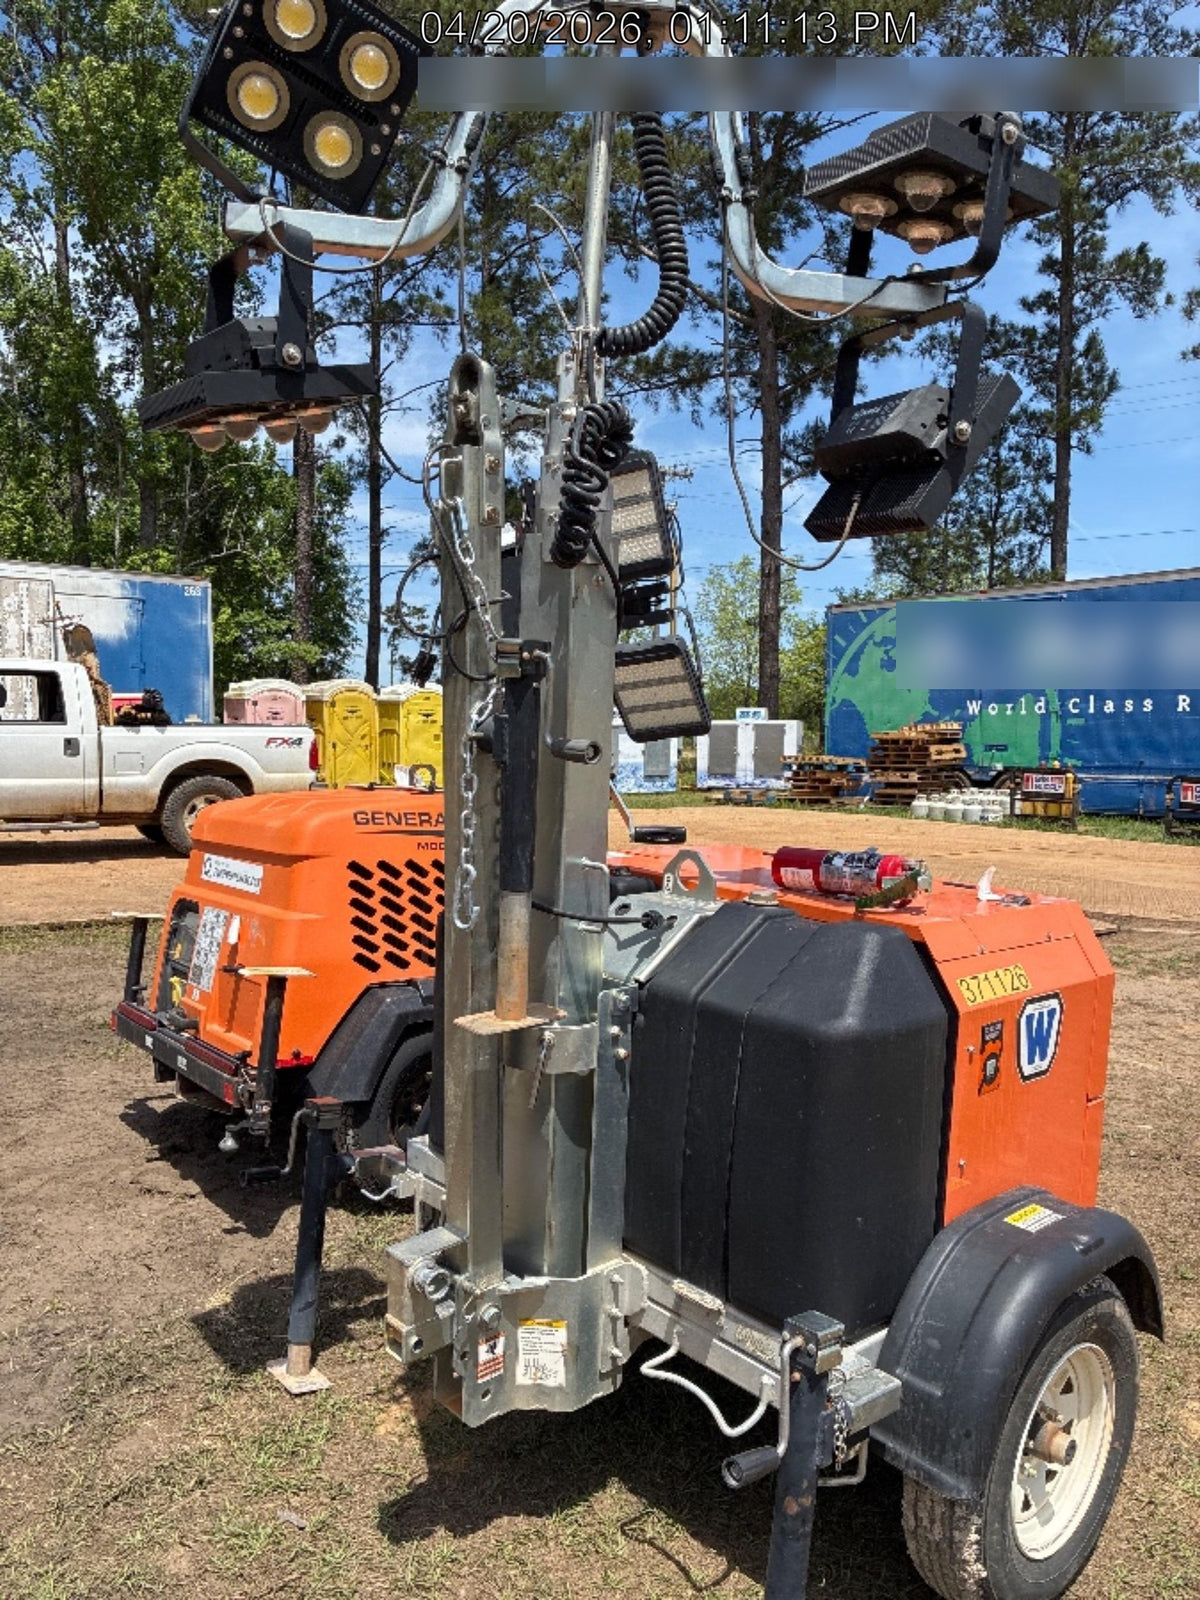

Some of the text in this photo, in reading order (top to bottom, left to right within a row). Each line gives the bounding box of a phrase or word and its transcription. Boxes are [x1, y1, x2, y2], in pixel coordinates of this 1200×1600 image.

[967, 697, 1046, 715] World
[1068, 694, 1153, 713] Class
[266, 737, 303, 746] FX4
[353, 810, 445, 827] GENERA
[959, 964, 1029, 1003] 371126
[1026, 1007, 1057, 1065] W
